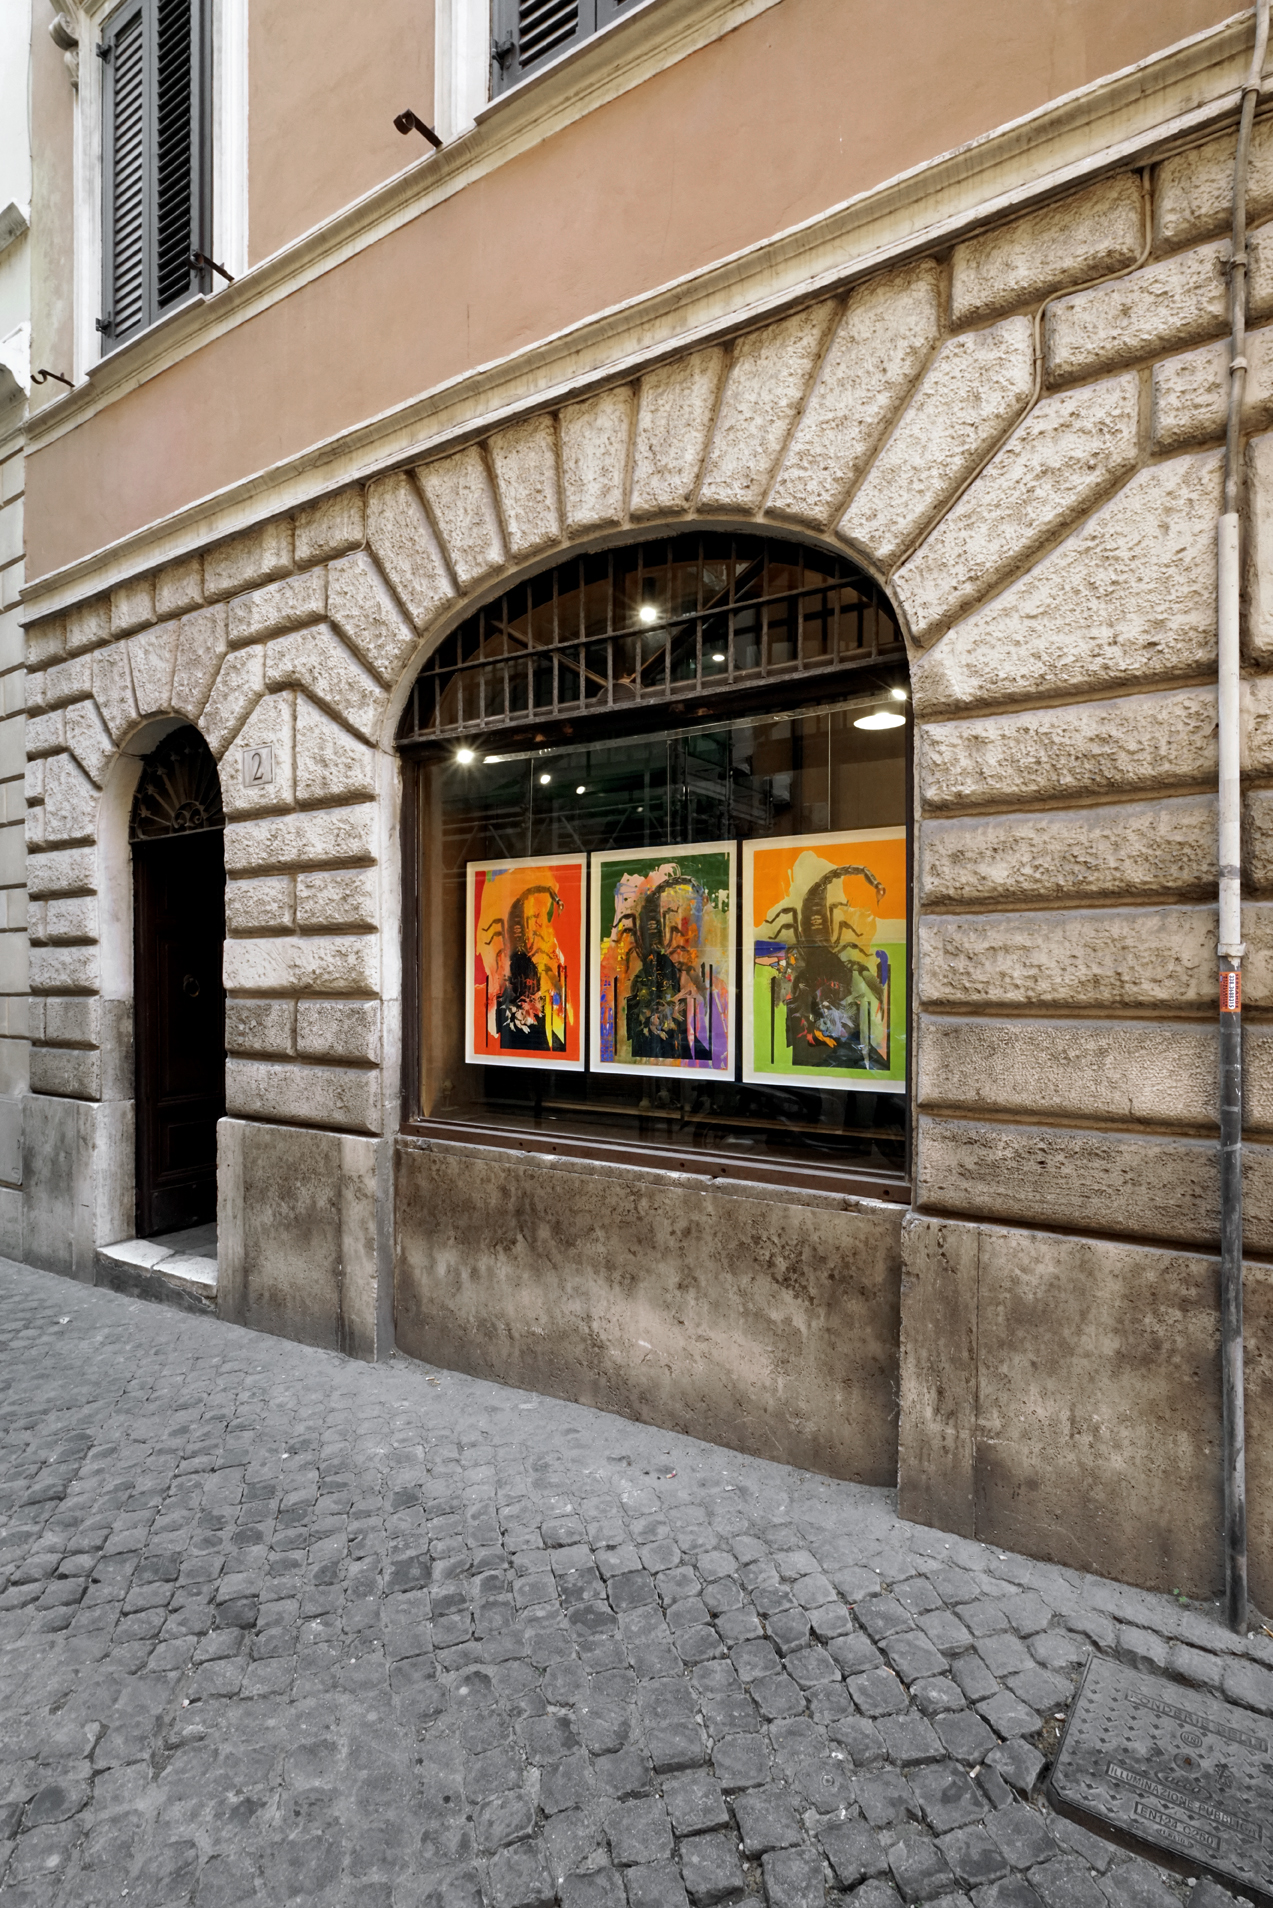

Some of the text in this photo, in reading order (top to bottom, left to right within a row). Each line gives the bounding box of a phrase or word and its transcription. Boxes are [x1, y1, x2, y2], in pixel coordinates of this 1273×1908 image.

[252, 753, 264, 781] 2
[1129, 1691, 1211, 1729] FONDERIE
[1110, 1765, 1194, 1808] ILLUMINAZIONE
[1199, 1801, 1257, 1838] PUBBLICA
[1140, 1804, 1178, 1830] EN124
